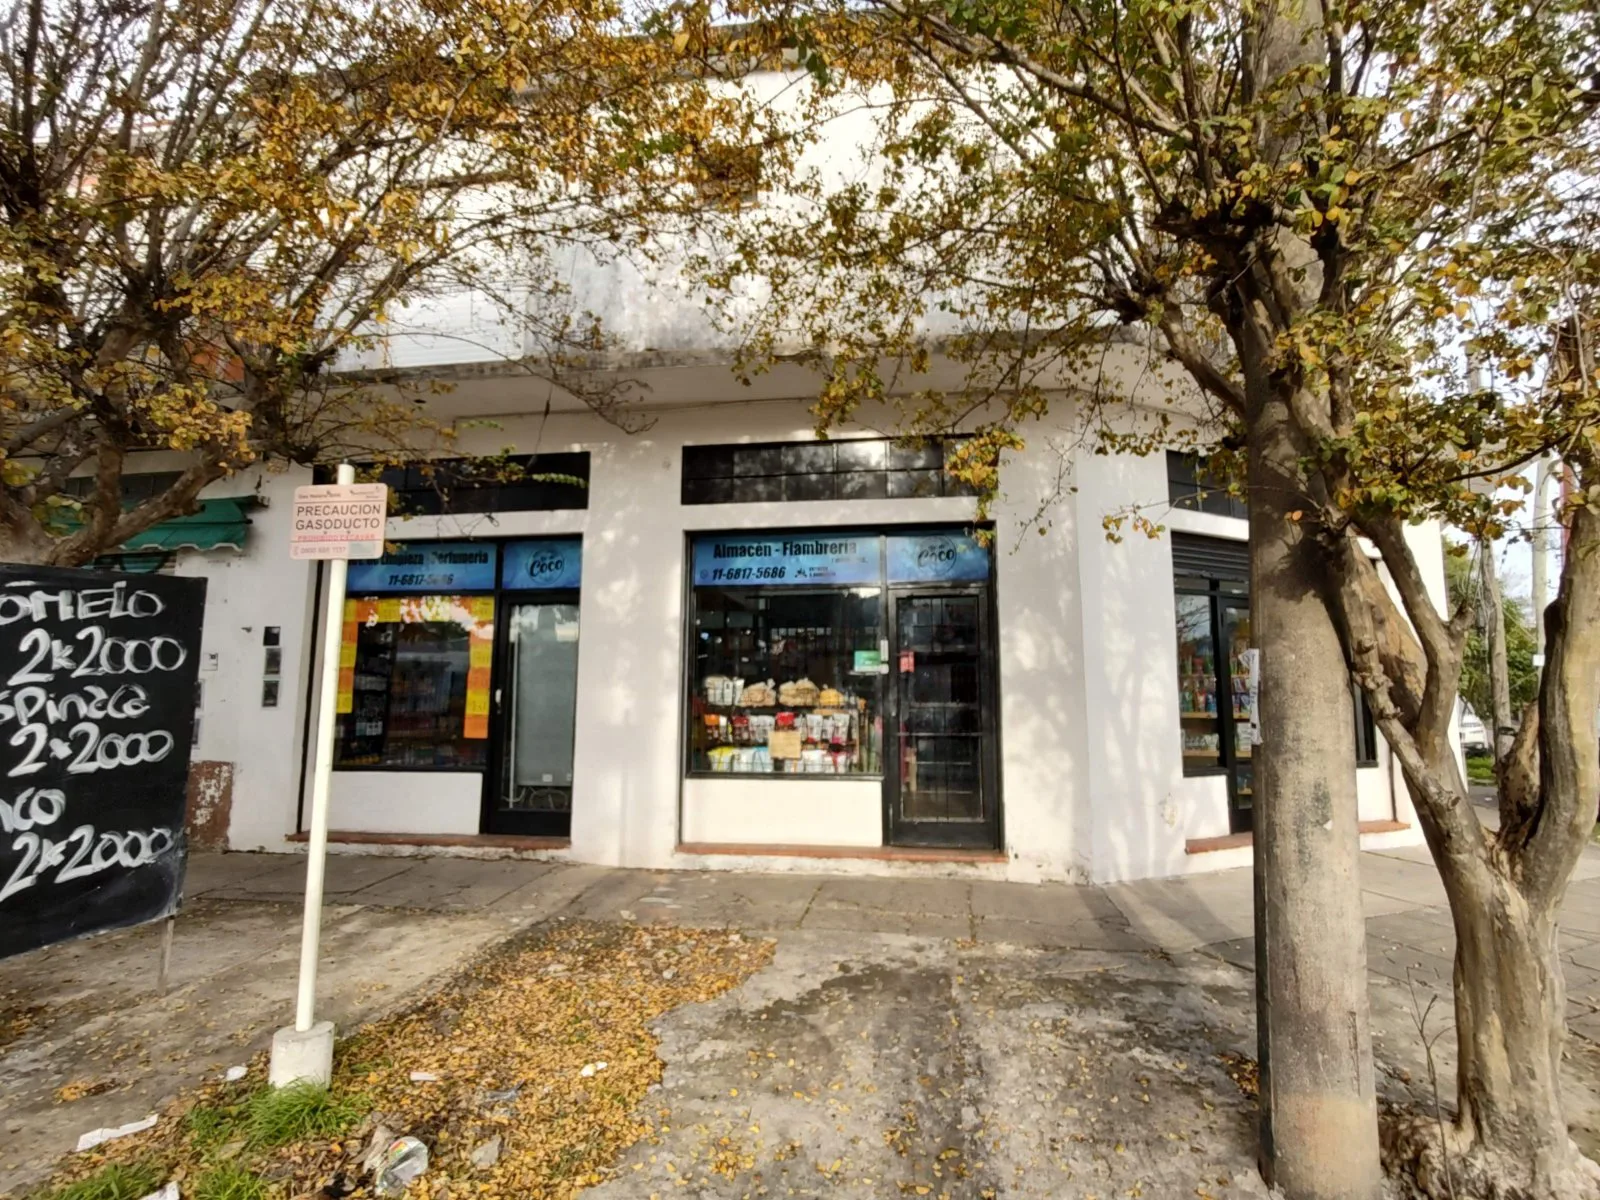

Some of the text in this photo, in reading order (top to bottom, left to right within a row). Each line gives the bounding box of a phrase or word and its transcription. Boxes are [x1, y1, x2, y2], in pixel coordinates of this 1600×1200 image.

[297, 504, 380, 516] PRECAUCION
[295, 518, 380, 531] GASODUCTO
[713, 542, 772, 559] Almacén
[530, 559, 563, 577] Coco
[712, 566, 786, 580] 11-6817-5686
